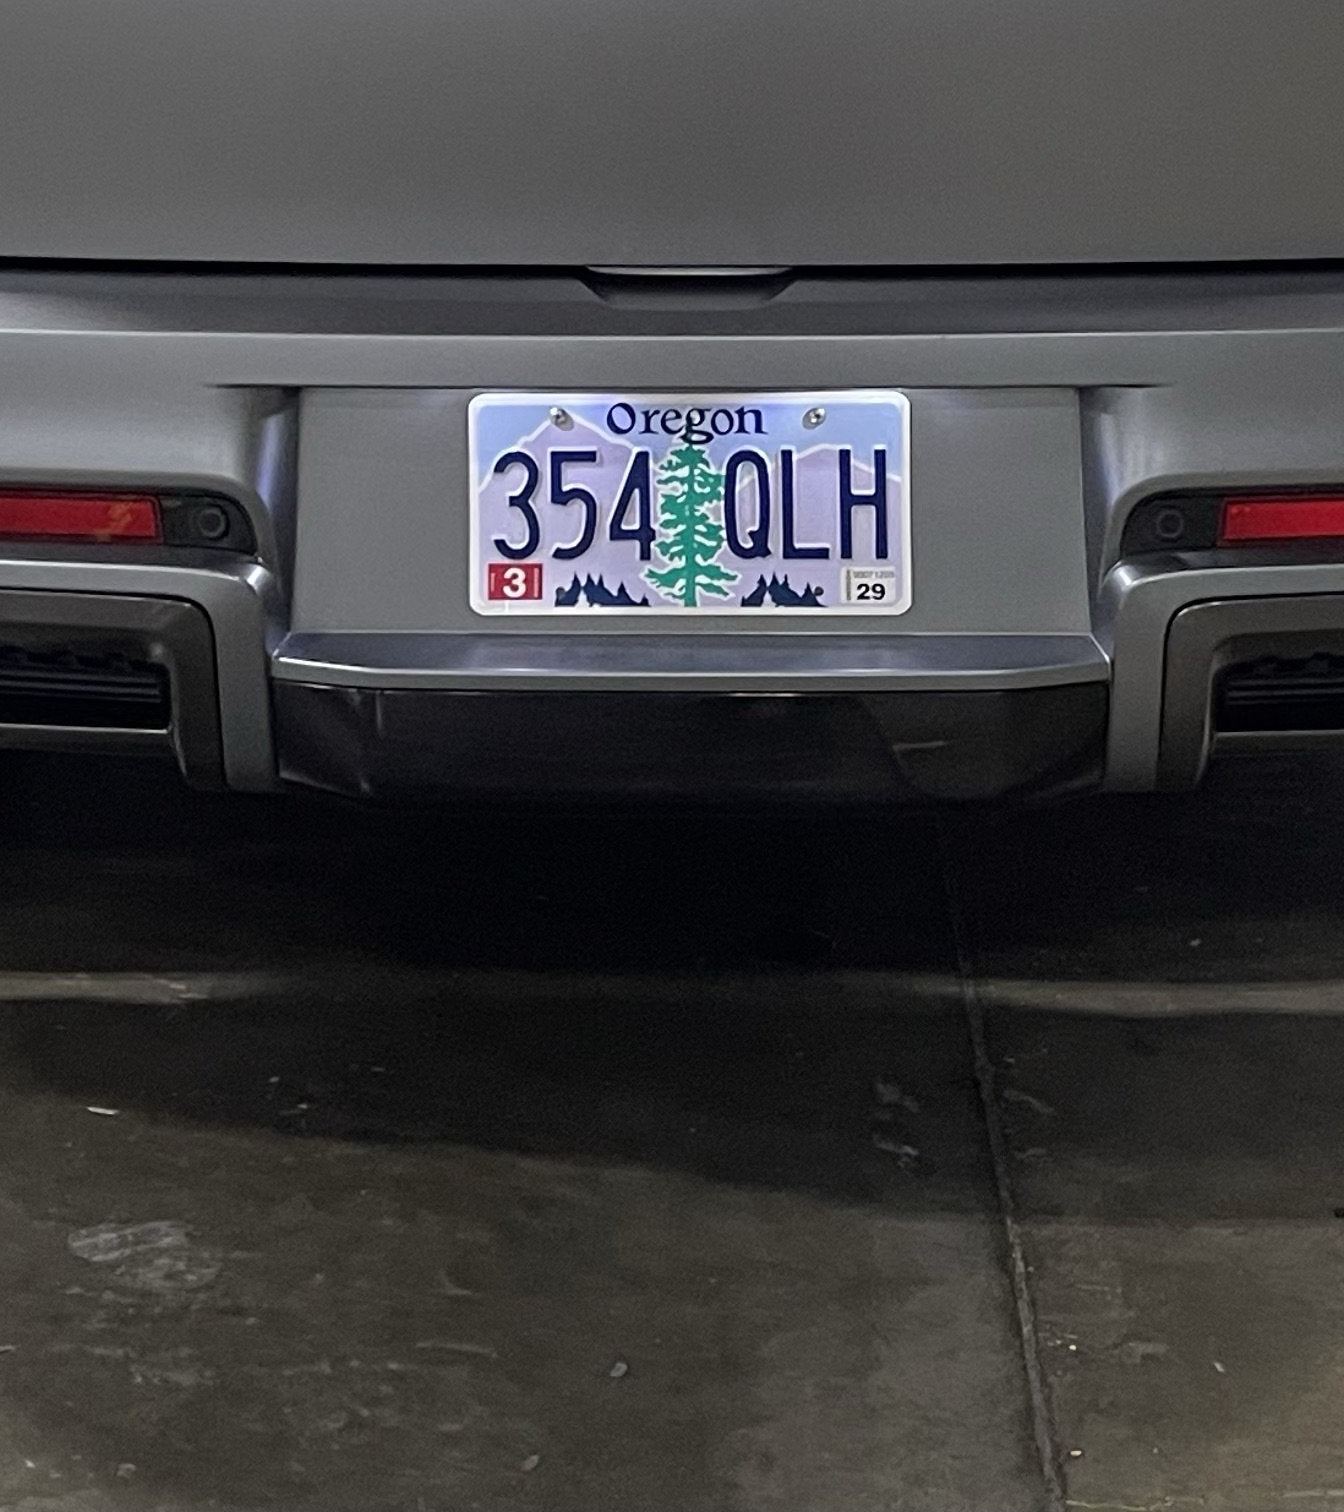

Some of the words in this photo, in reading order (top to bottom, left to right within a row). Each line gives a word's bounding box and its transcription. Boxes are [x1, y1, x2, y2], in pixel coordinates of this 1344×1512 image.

[606, 401, 769, 446] Oregon
[492, 449, 656, 562] 354
[723, 448, 889, 561] QLH
[503, 567, 527, 599] 3
[856, 583, 886, 601] 29
